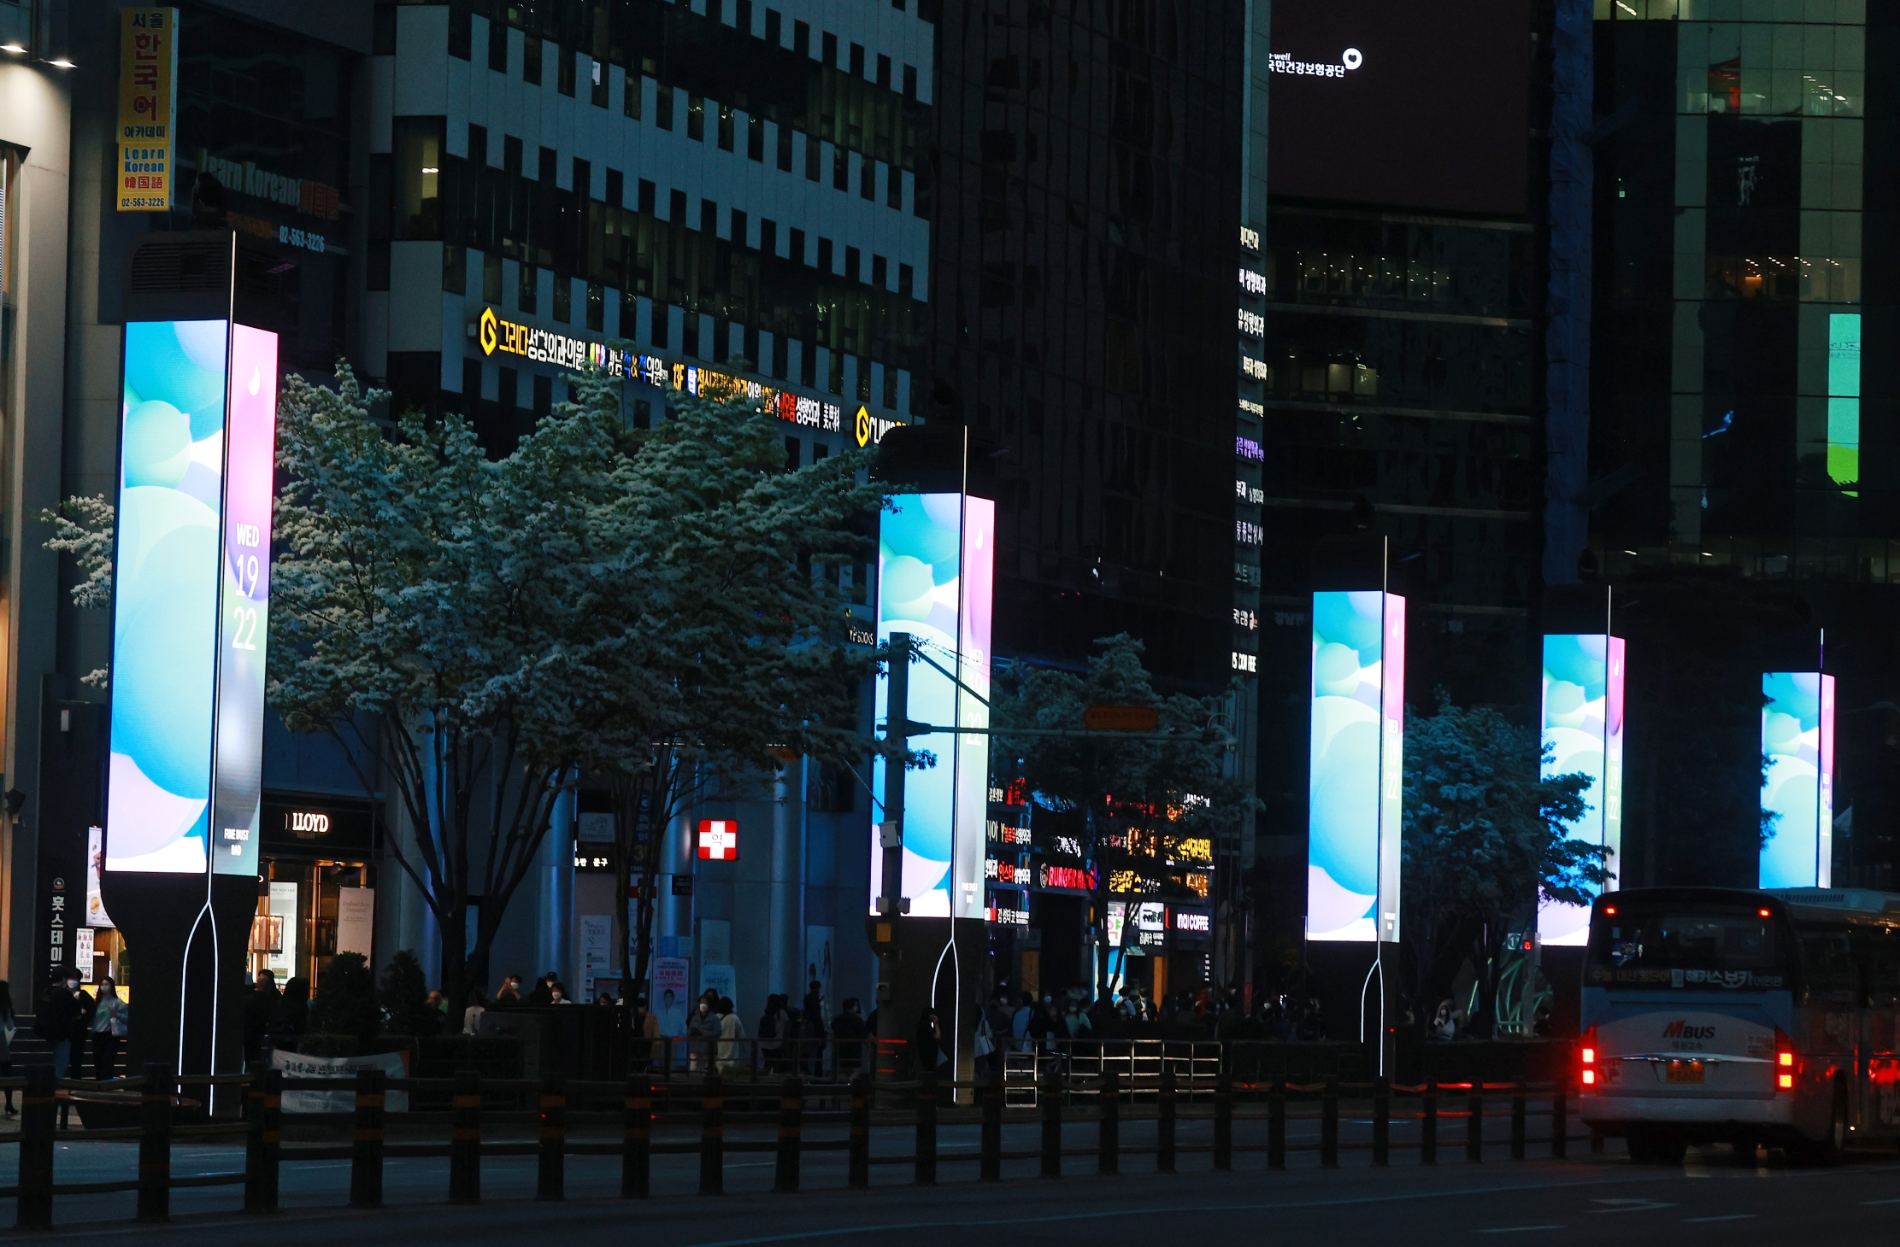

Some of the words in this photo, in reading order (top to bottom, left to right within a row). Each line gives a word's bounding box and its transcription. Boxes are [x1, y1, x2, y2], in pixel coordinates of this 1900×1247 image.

[132, 13, 163, 29] 서울
[133, 33, 162, 122] 한국어
[124, 125, 165, 139] 아카데미
[124, 147, 165, 160] Learn
[124, 161, 165, 173] Korean
[121, 197, 165, 208] 02-563-3226
[279, 225, 326, 255] 02-563-3226
[236, 522, 260, 548] WED
[235, 553, 259, 598] 19
[232, 605, 257, 651] 22
[966, 712, 982, 746] 22
[292, 812, 329, 833] LLOYD
[224, 828, 236, 840] FINE
[236, 829, 250, 841] DUST
[711, 833, 724, 847] 약
[1048, 866, 1076, 887] BURGER
[49, 895, 65, 978] 훗스테이
[1616, 969, 1637, 983] 내신
[1662, 1020, 1716, 1039] MBUS
